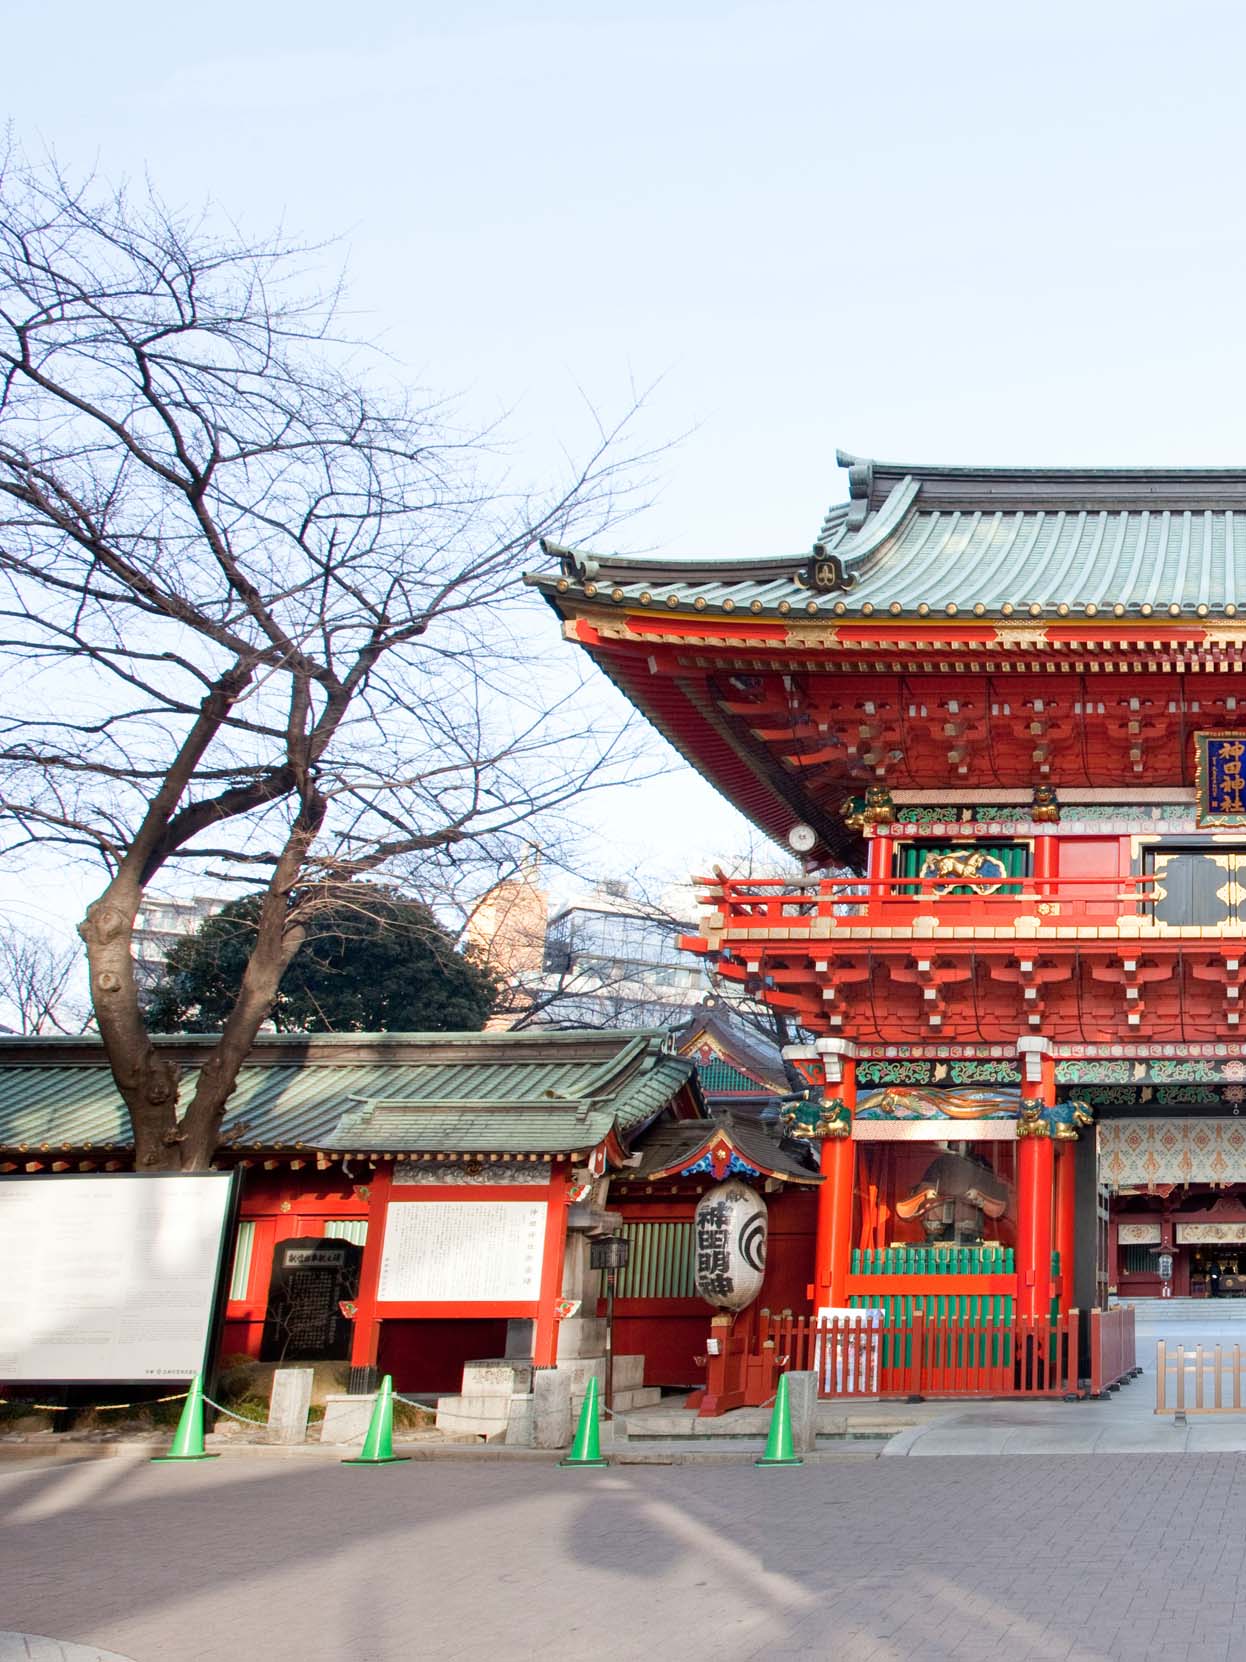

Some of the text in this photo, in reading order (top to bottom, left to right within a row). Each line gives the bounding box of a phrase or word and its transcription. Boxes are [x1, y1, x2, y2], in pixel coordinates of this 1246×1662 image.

[1219, 741, 1246, 813] 神田神社
[696, 1201, 735, 1298] 神田明神
